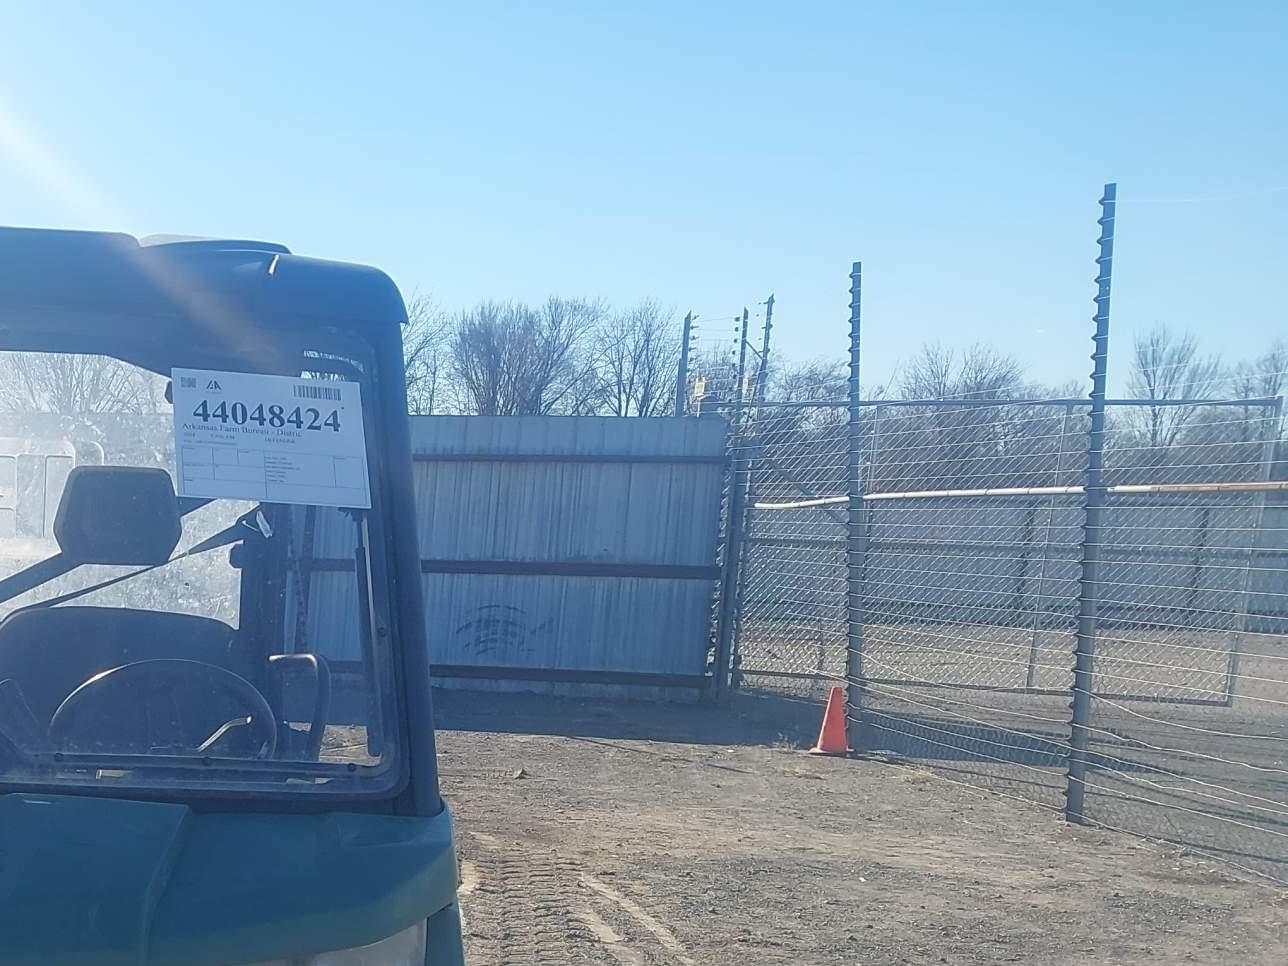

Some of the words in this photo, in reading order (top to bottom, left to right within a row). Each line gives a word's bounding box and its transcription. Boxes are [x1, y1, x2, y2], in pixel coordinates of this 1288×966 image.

[193, 399, 341, 432] 44048424
[183, 423, 218, 432] Arkansas
[220, 424, 240, 433] Farm
